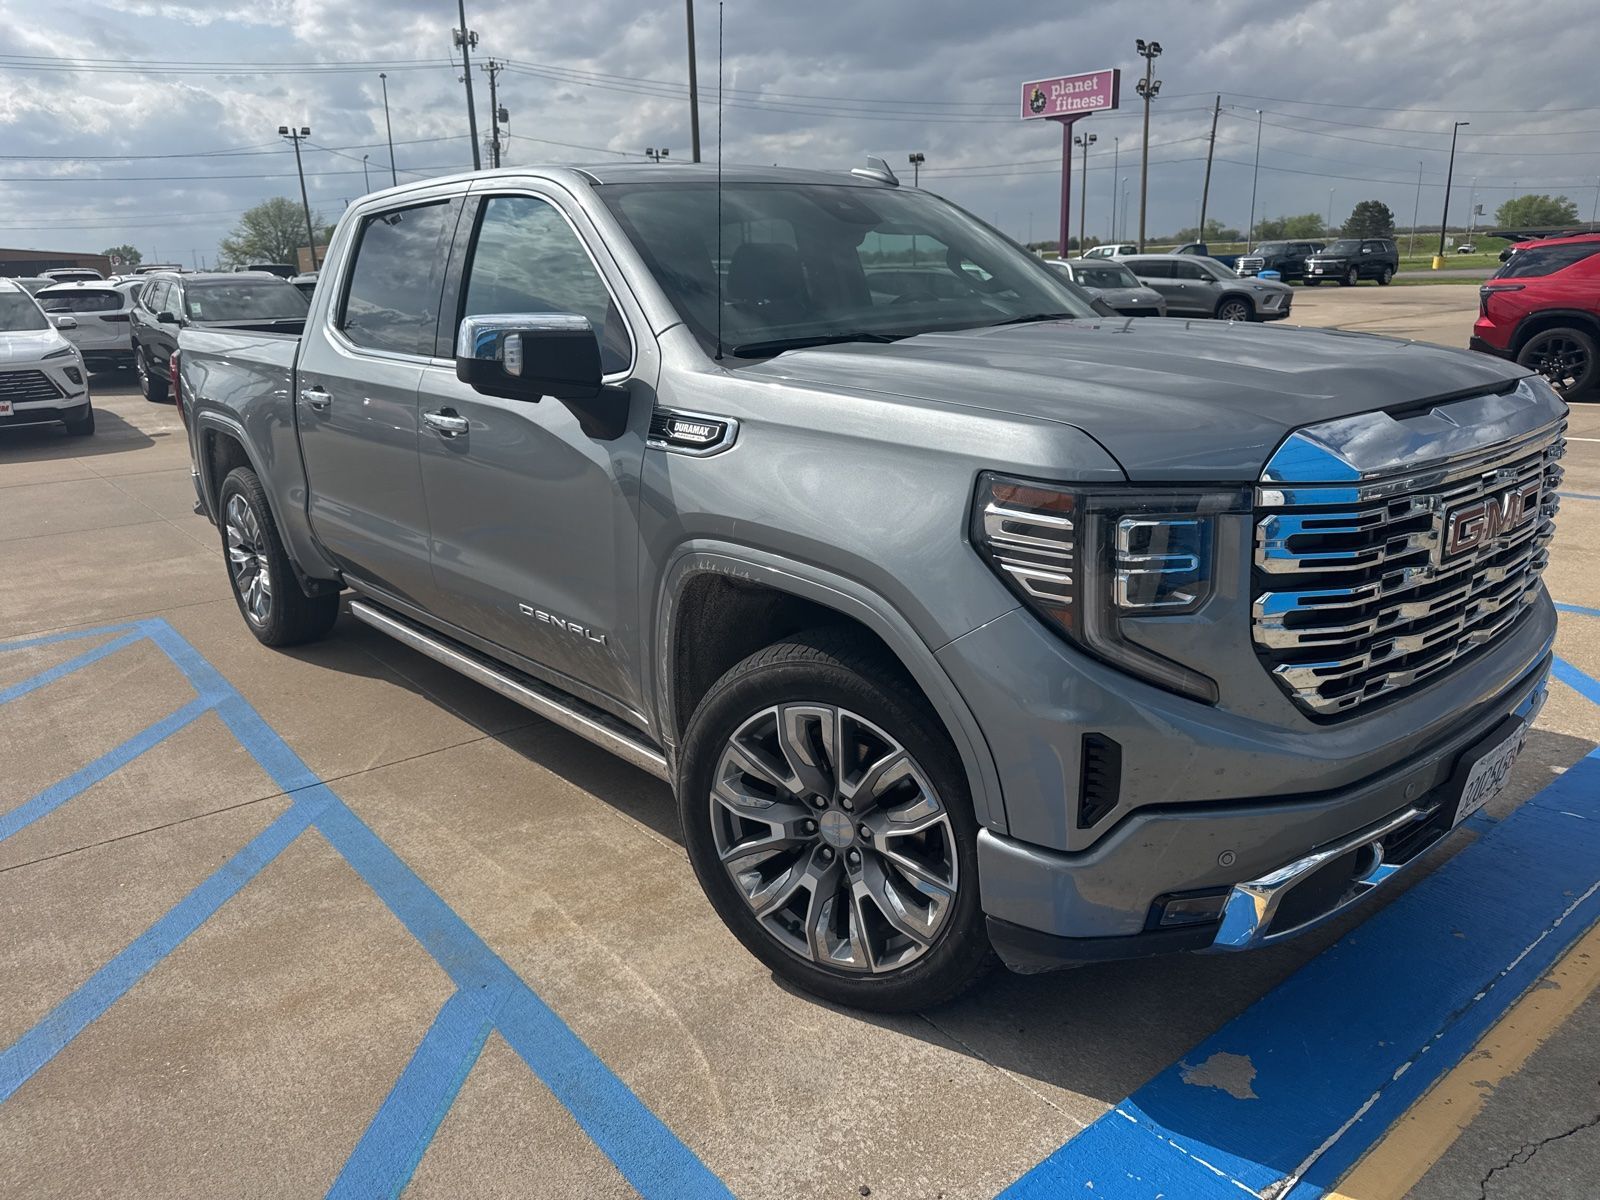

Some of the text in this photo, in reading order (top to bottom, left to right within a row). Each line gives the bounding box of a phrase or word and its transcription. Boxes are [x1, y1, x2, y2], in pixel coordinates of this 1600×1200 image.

[1051, 76, 1098, 99] planet
[1056, 95, 1104, 111] fitness
[674, 422, 710, 436] DURAMAX
[1449, 479, 1541, 555] GMC
[519, 603, 607, 646] DENALI
